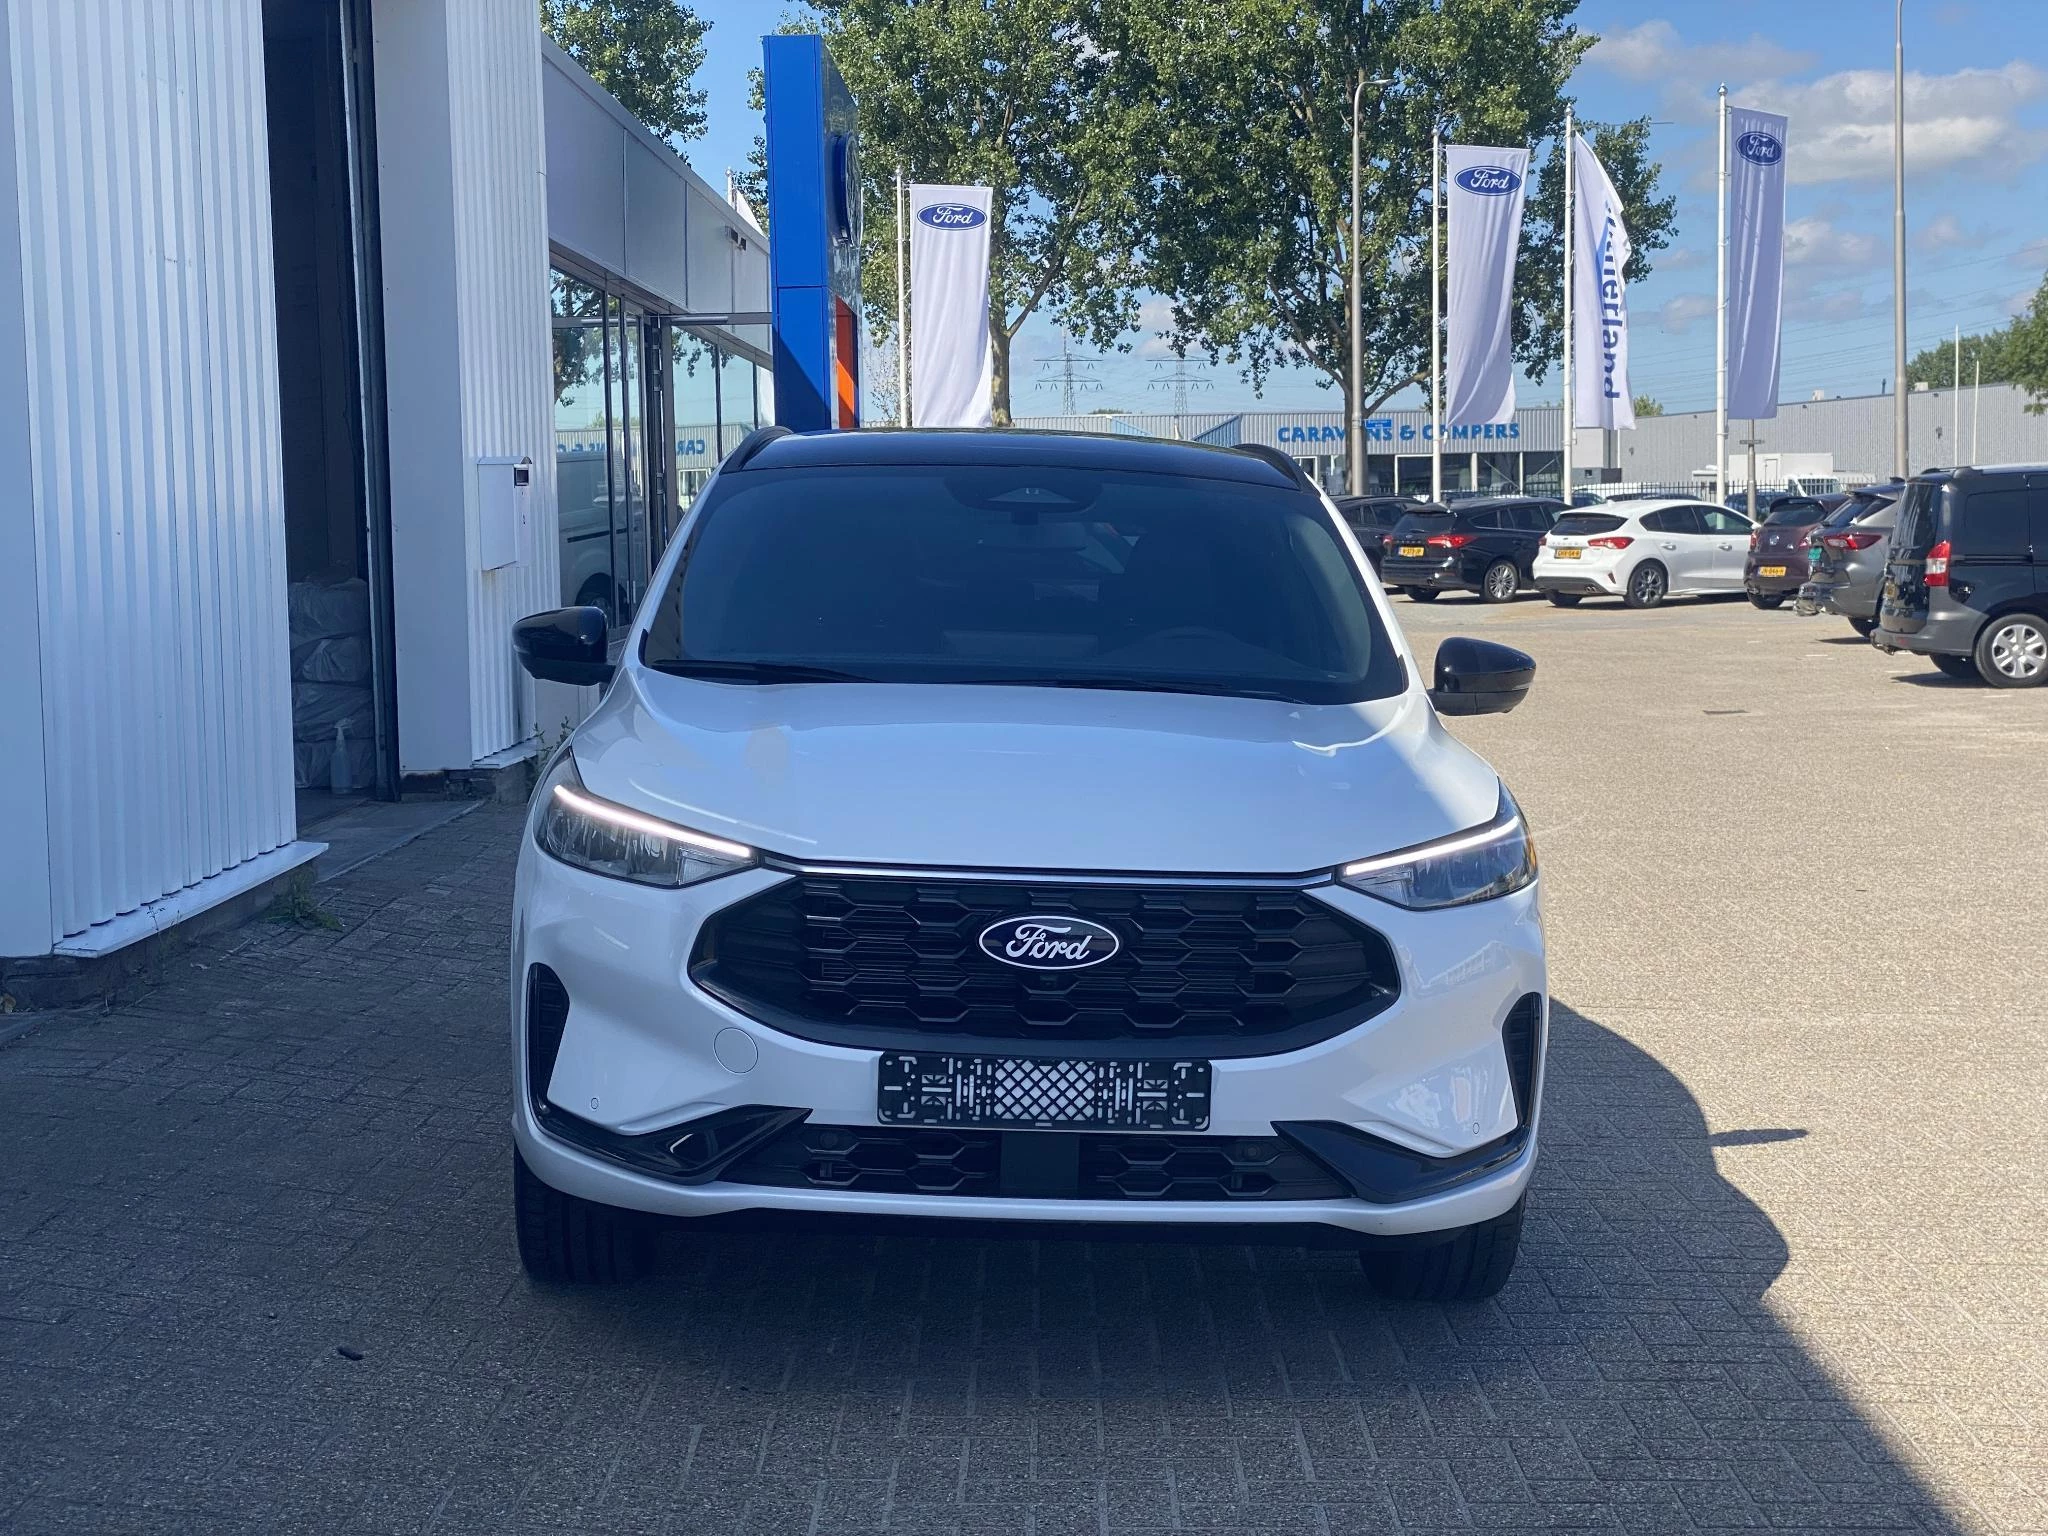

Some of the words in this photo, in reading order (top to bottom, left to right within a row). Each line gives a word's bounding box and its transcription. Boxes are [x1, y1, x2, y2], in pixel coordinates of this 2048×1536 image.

[1746, 135, 1775, 158] Ford
[1470, 169, 1510, 189] Ford
[932, 206, 974, 224] Ford
[1278, 426, 1393, 443] CARAVNS
[1400, 424, 1416, 441] &
[1005, 923, 1092, 960] Ford
